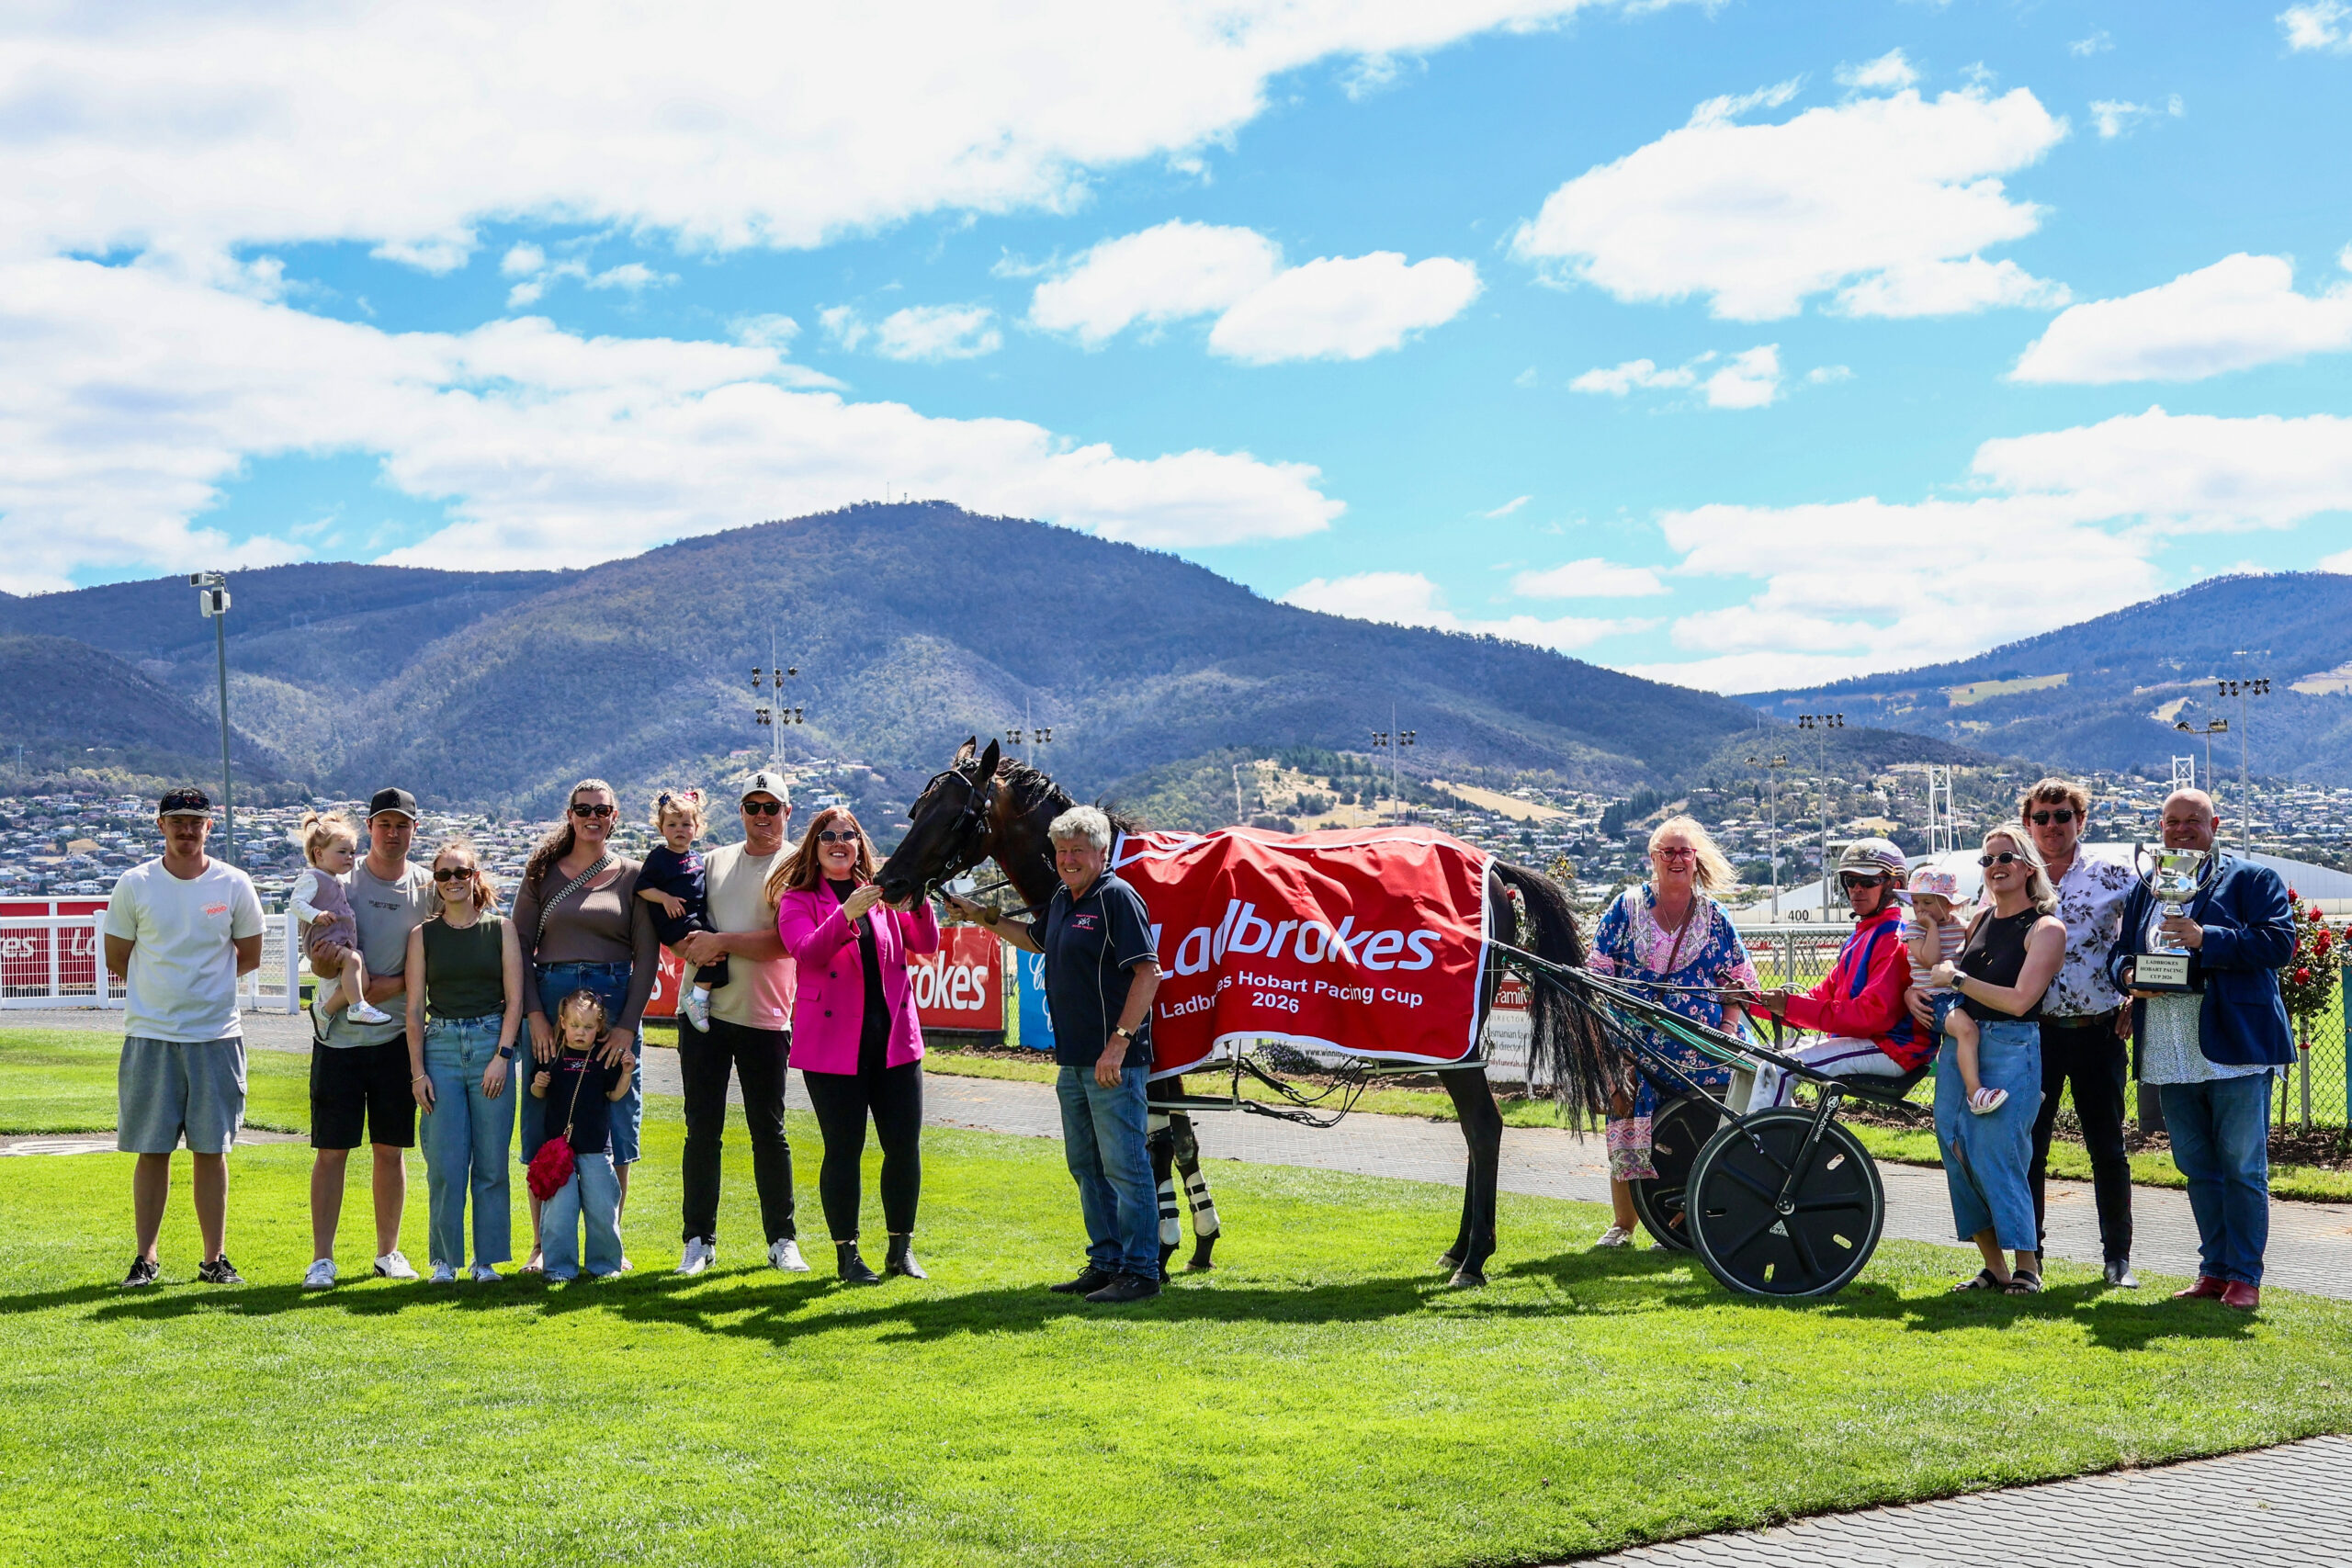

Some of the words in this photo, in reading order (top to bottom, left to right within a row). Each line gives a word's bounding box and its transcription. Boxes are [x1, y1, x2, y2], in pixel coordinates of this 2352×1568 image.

[755, 774, 768, 788] LA
[1788, 909, 1809, 921] 400
[1150, 898, 1442, 980] Ladbrokes
[1160, 976, 1232, 1019] Ladbres
[1238, 971, 1308, 993] Hobart
[1314, 980, 1374, 1005] Pacing
[1381, 987, 1423, 1009] Cup
[1251, 992, 1300, 1013] 2026
[1726, 1035, 1755, 1053] Racing
